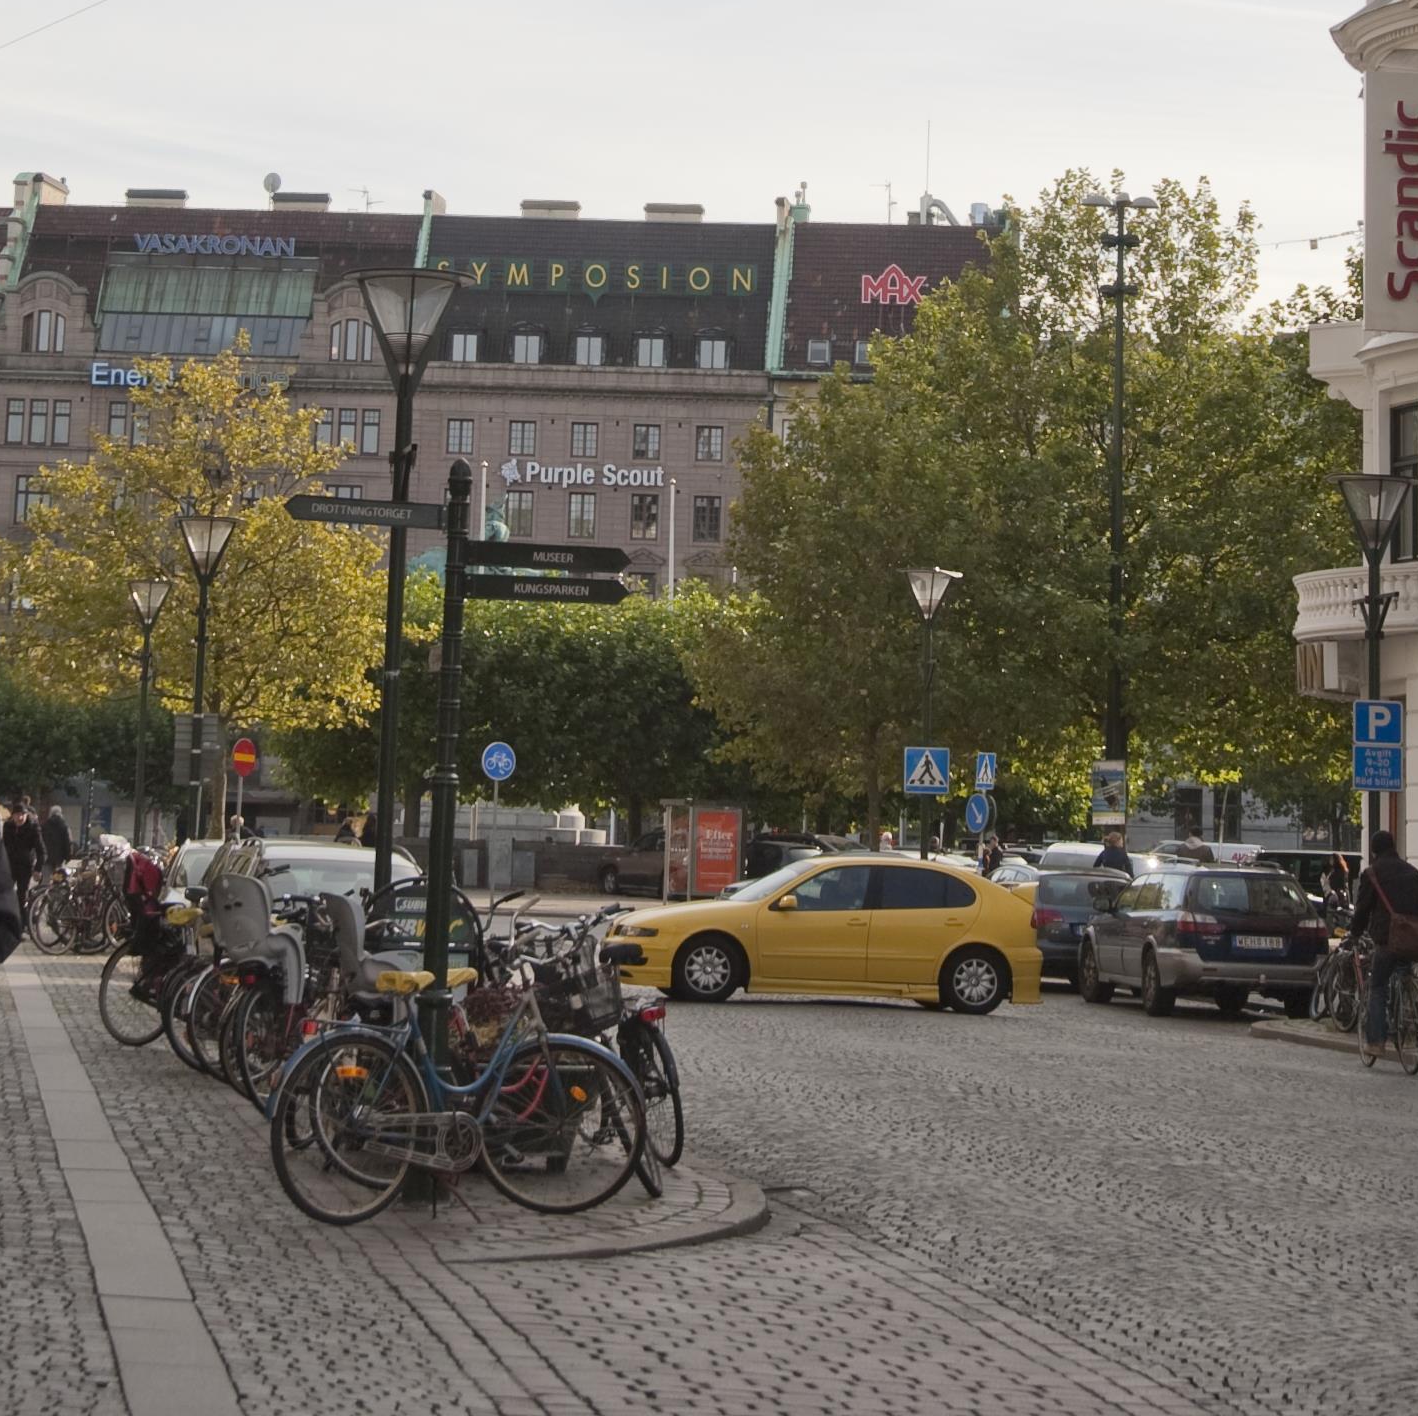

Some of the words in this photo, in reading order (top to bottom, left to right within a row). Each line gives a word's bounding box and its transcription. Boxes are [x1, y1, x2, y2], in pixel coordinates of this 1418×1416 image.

[133, 232, 296, 257] VASAKRONAN
[861, 263, 928, 305] MAX
[525, 461, 595, 489] Purple
[602, 464, 665, 487] Scout
[311, 502, 413, 520] DROTTNINGTORGET
[532, 550, 574, 564] MUSEER
[513, 582, 590, 597] KUNGSPARKEN
[1368, 705, 1392, 740] P
[1364, 748, 1392, 760] Avgift
[1366, 758, 1390, 767] 9-20
[1364, 767, 1392, 777] (9-16)
